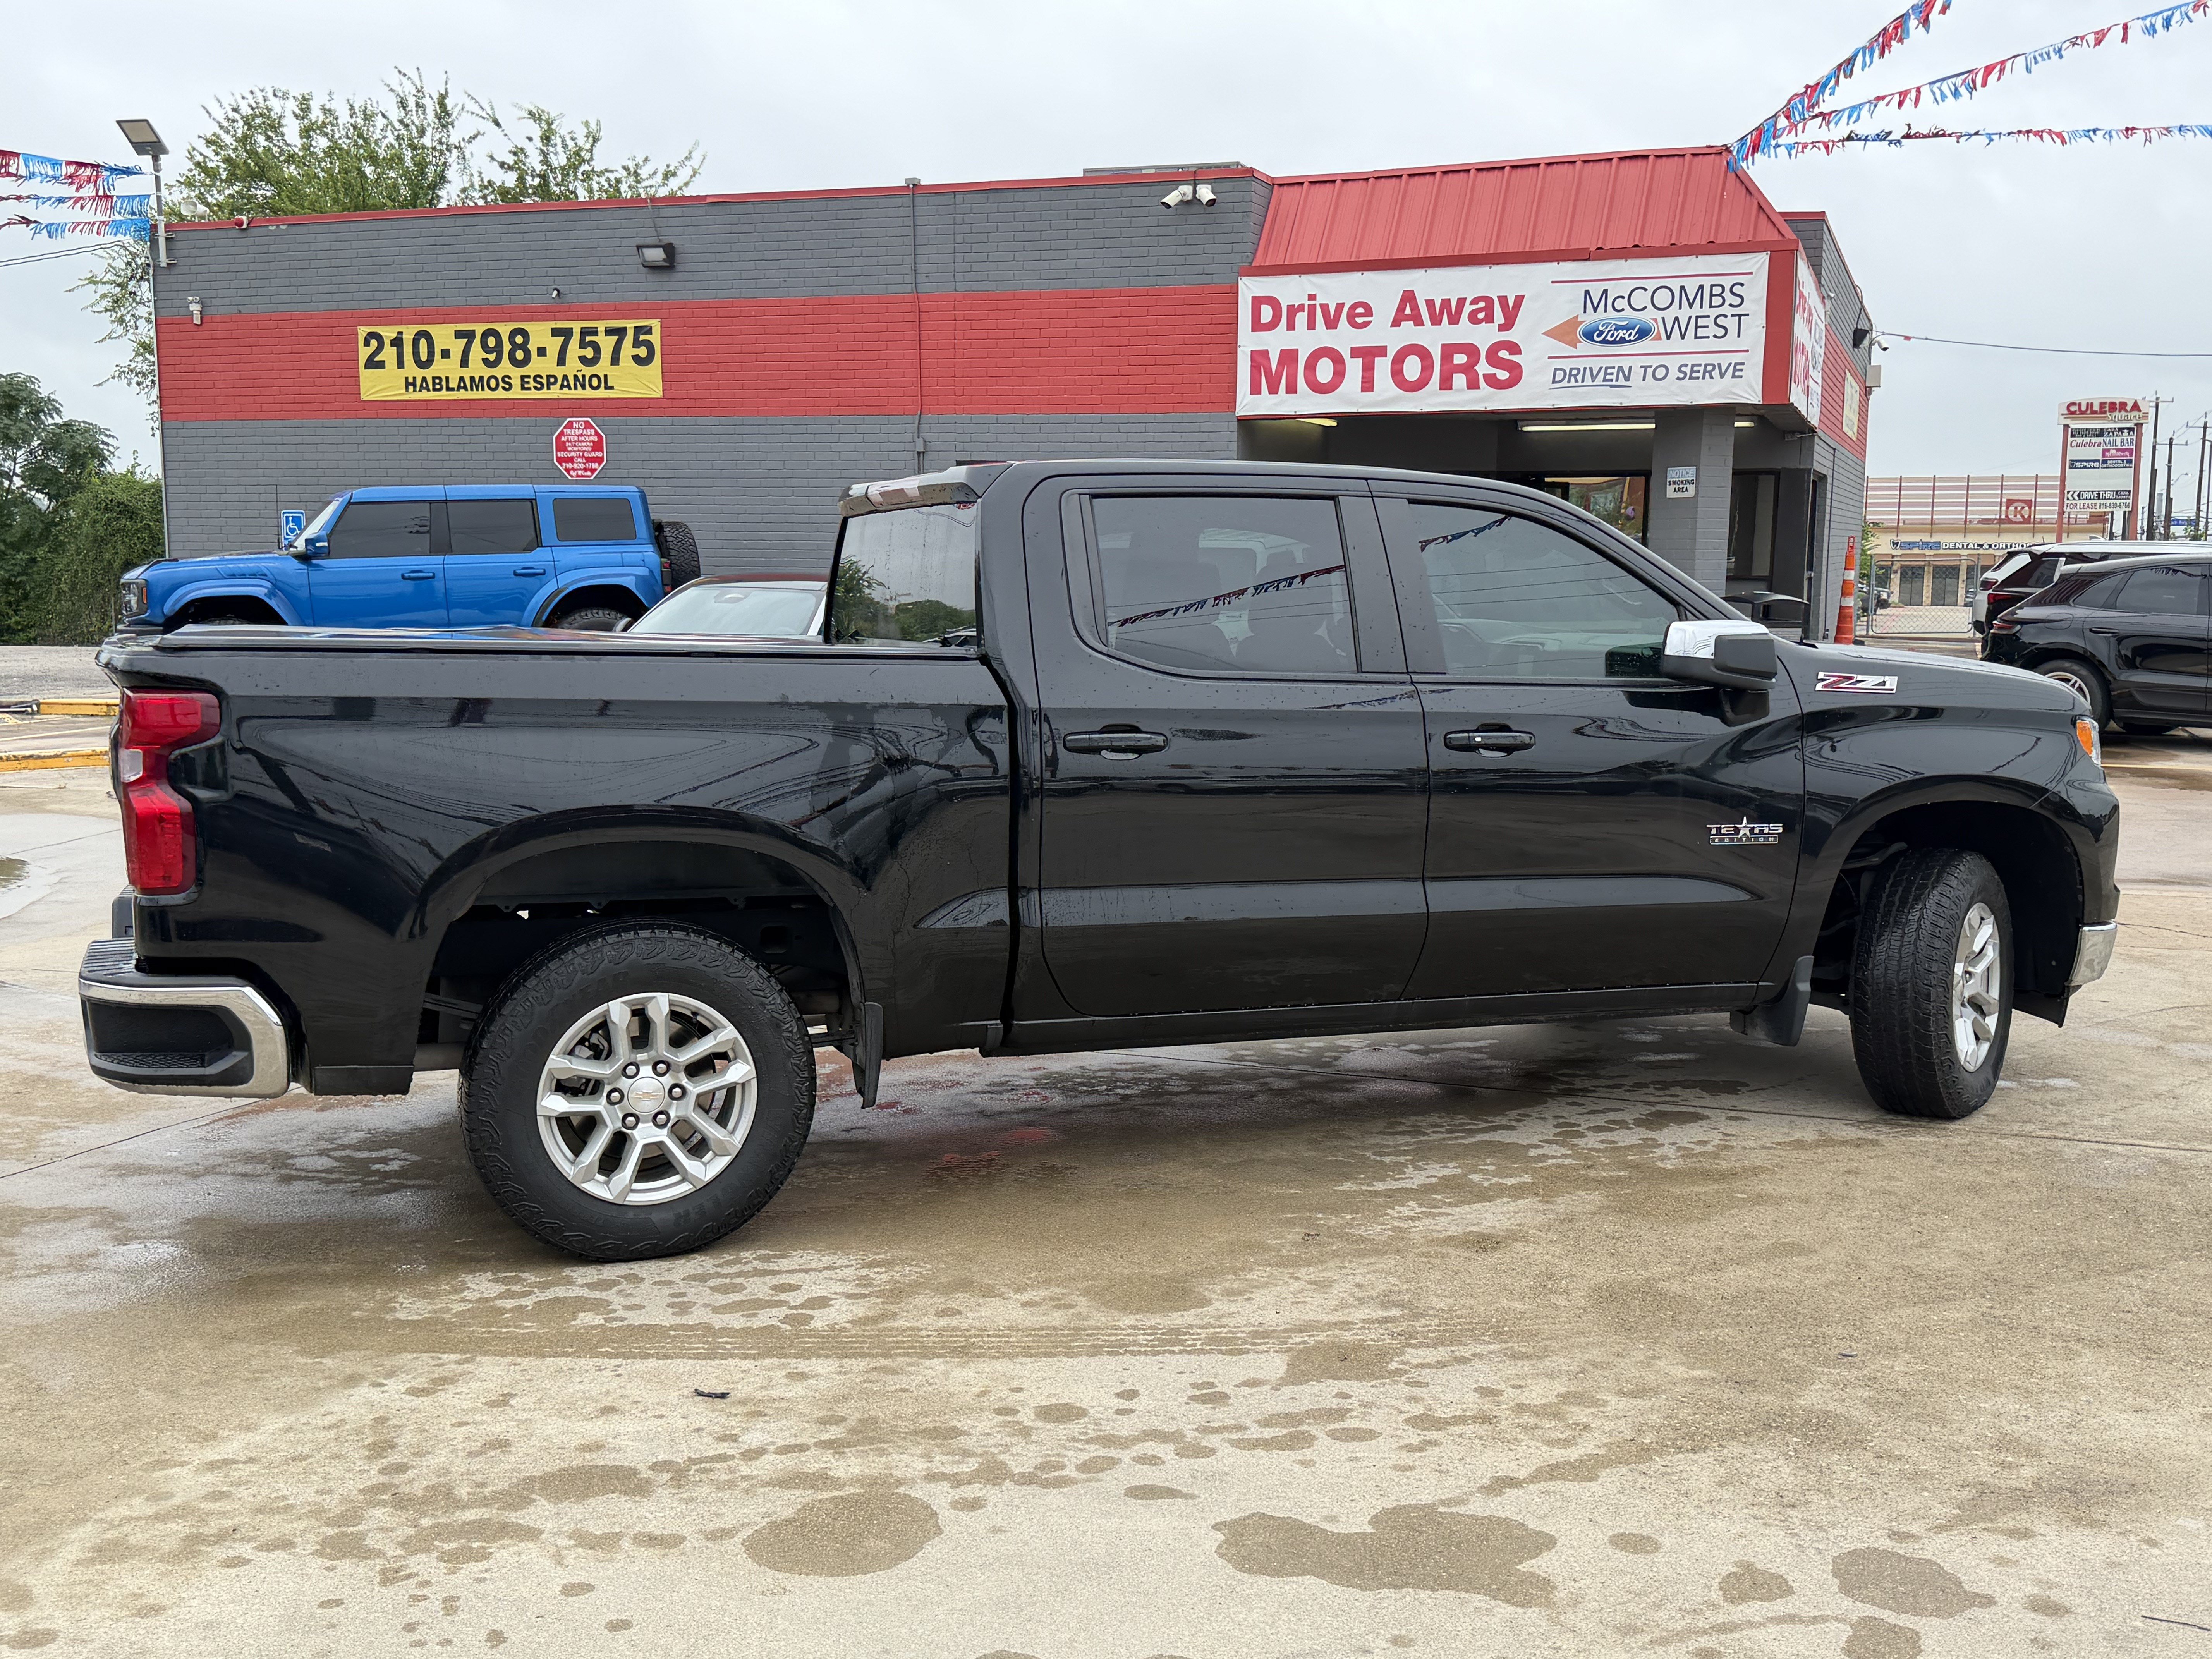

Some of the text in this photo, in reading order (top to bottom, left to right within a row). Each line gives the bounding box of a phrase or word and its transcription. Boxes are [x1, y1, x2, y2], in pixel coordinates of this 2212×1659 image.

[1583, 282, 1745, 314] McCOMBS
[1250, 289, 1526, 333] Drive Away
[1594, 313, 1750, 341] Ford WEST
[363, 325, 656, 371] 210-798-7575
[1249, 339, 1523, 395] MOTORS
[1551, 361, 1746, 385] DRIVEN TO SERVE
[405, 369, 615, 393] HABLAMOS ESPAÑOL
[2066, 399, 2142, 414] CULEBRA
[2107, 413, 2142, 422] Square
[2070, 438, 2134, 448] Culebra NAIL BAR
[1669, 469, 1694, 478] NOTICE
[2080, 491, 2098, 500] DRIVE
[2099, 491, 2116, 500] THRU
[1815, 672, 1898, 693] Z71
[1706, 817, 1783, 837] TEXAS
